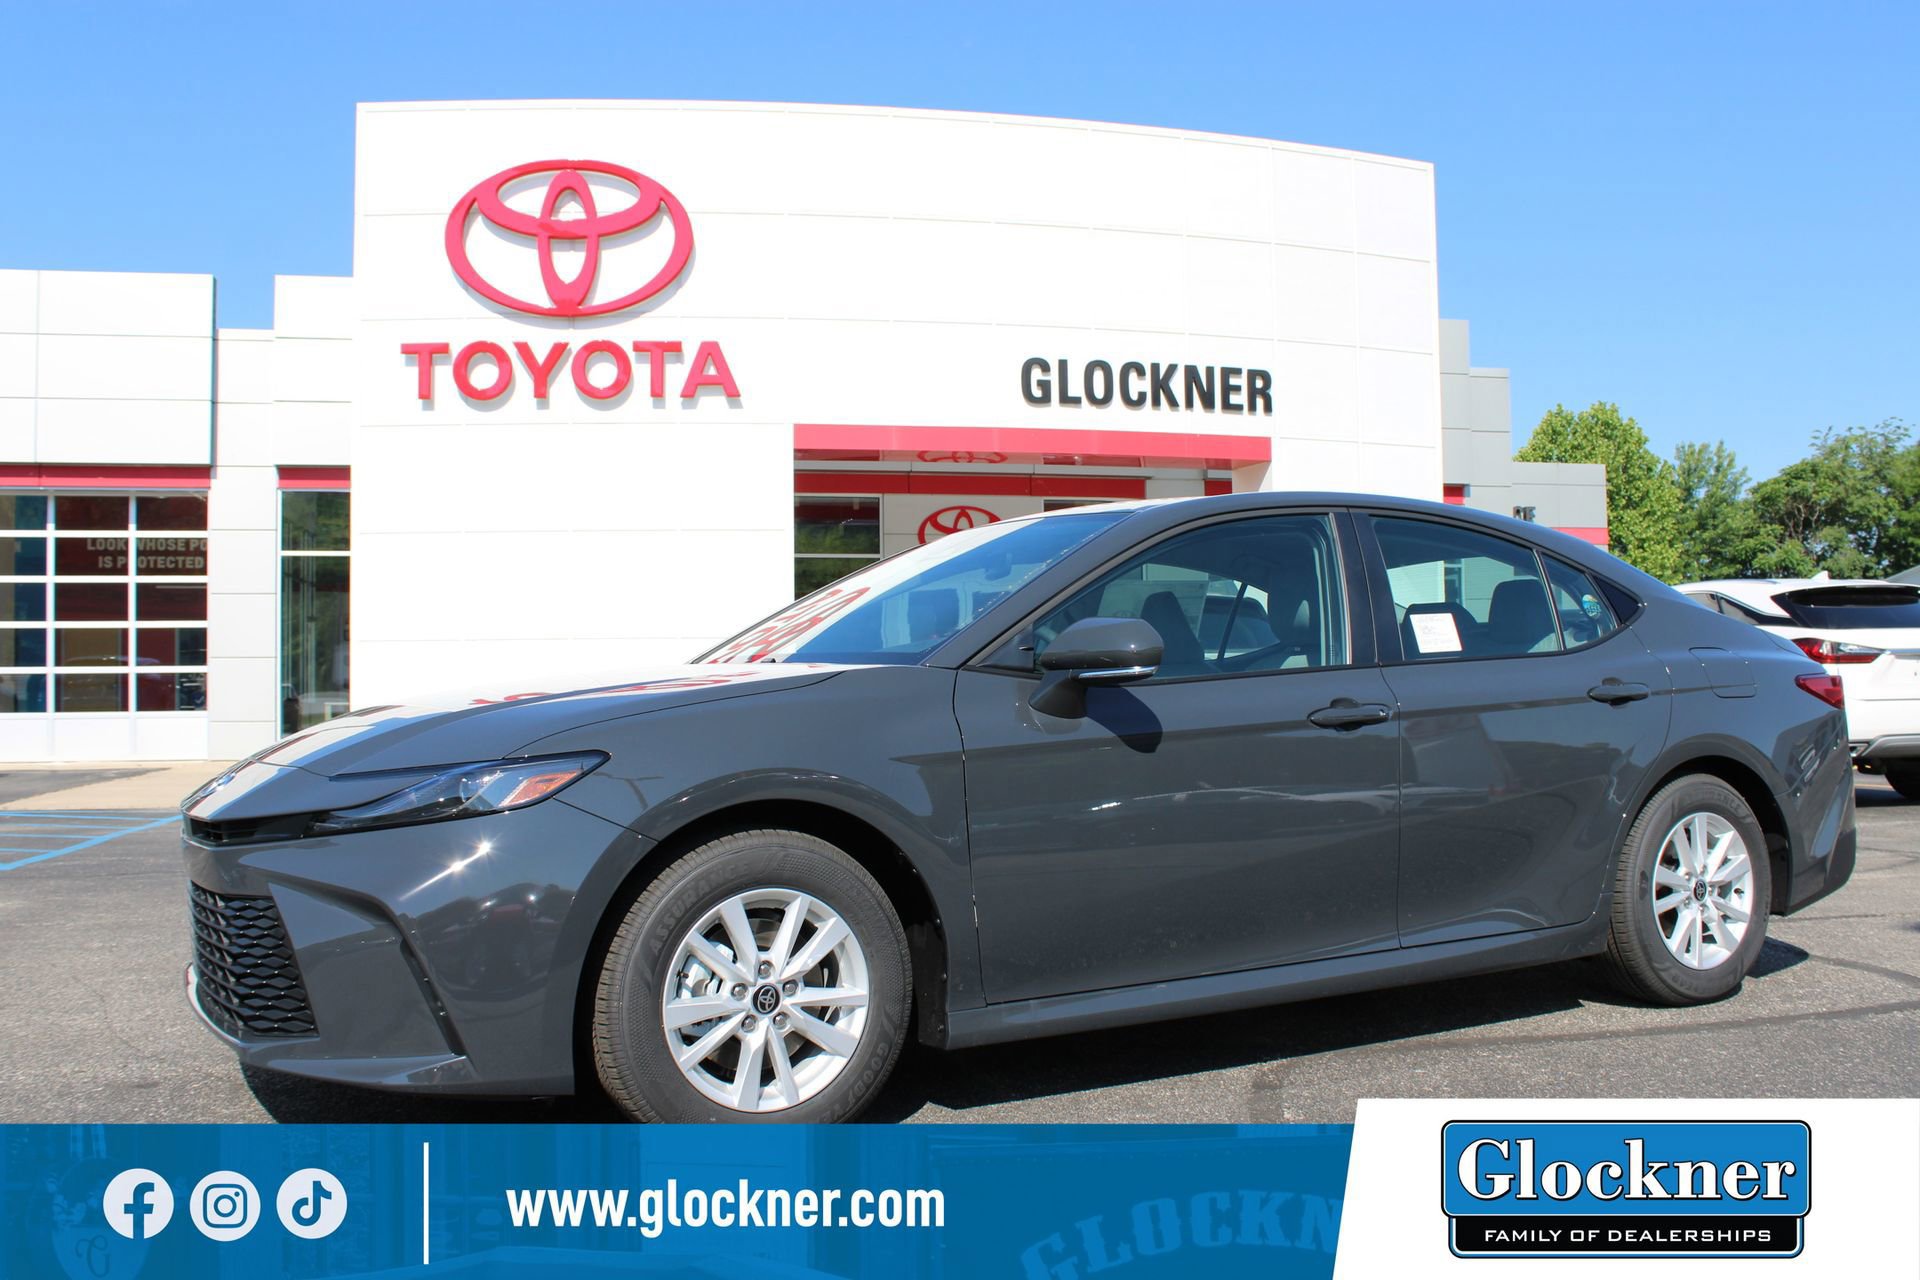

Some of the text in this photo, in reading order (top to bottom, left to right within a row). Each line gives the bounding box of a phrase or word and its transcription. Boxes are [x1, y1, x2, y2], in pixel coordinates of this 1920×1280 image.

[400, 340, 742, 401] TOYOTA
[1021, 357, 1273, 413] GLOCKNER
[87, 538, 127, 550] LOOK
[98, 556, 204, 569] IS POTECTED
